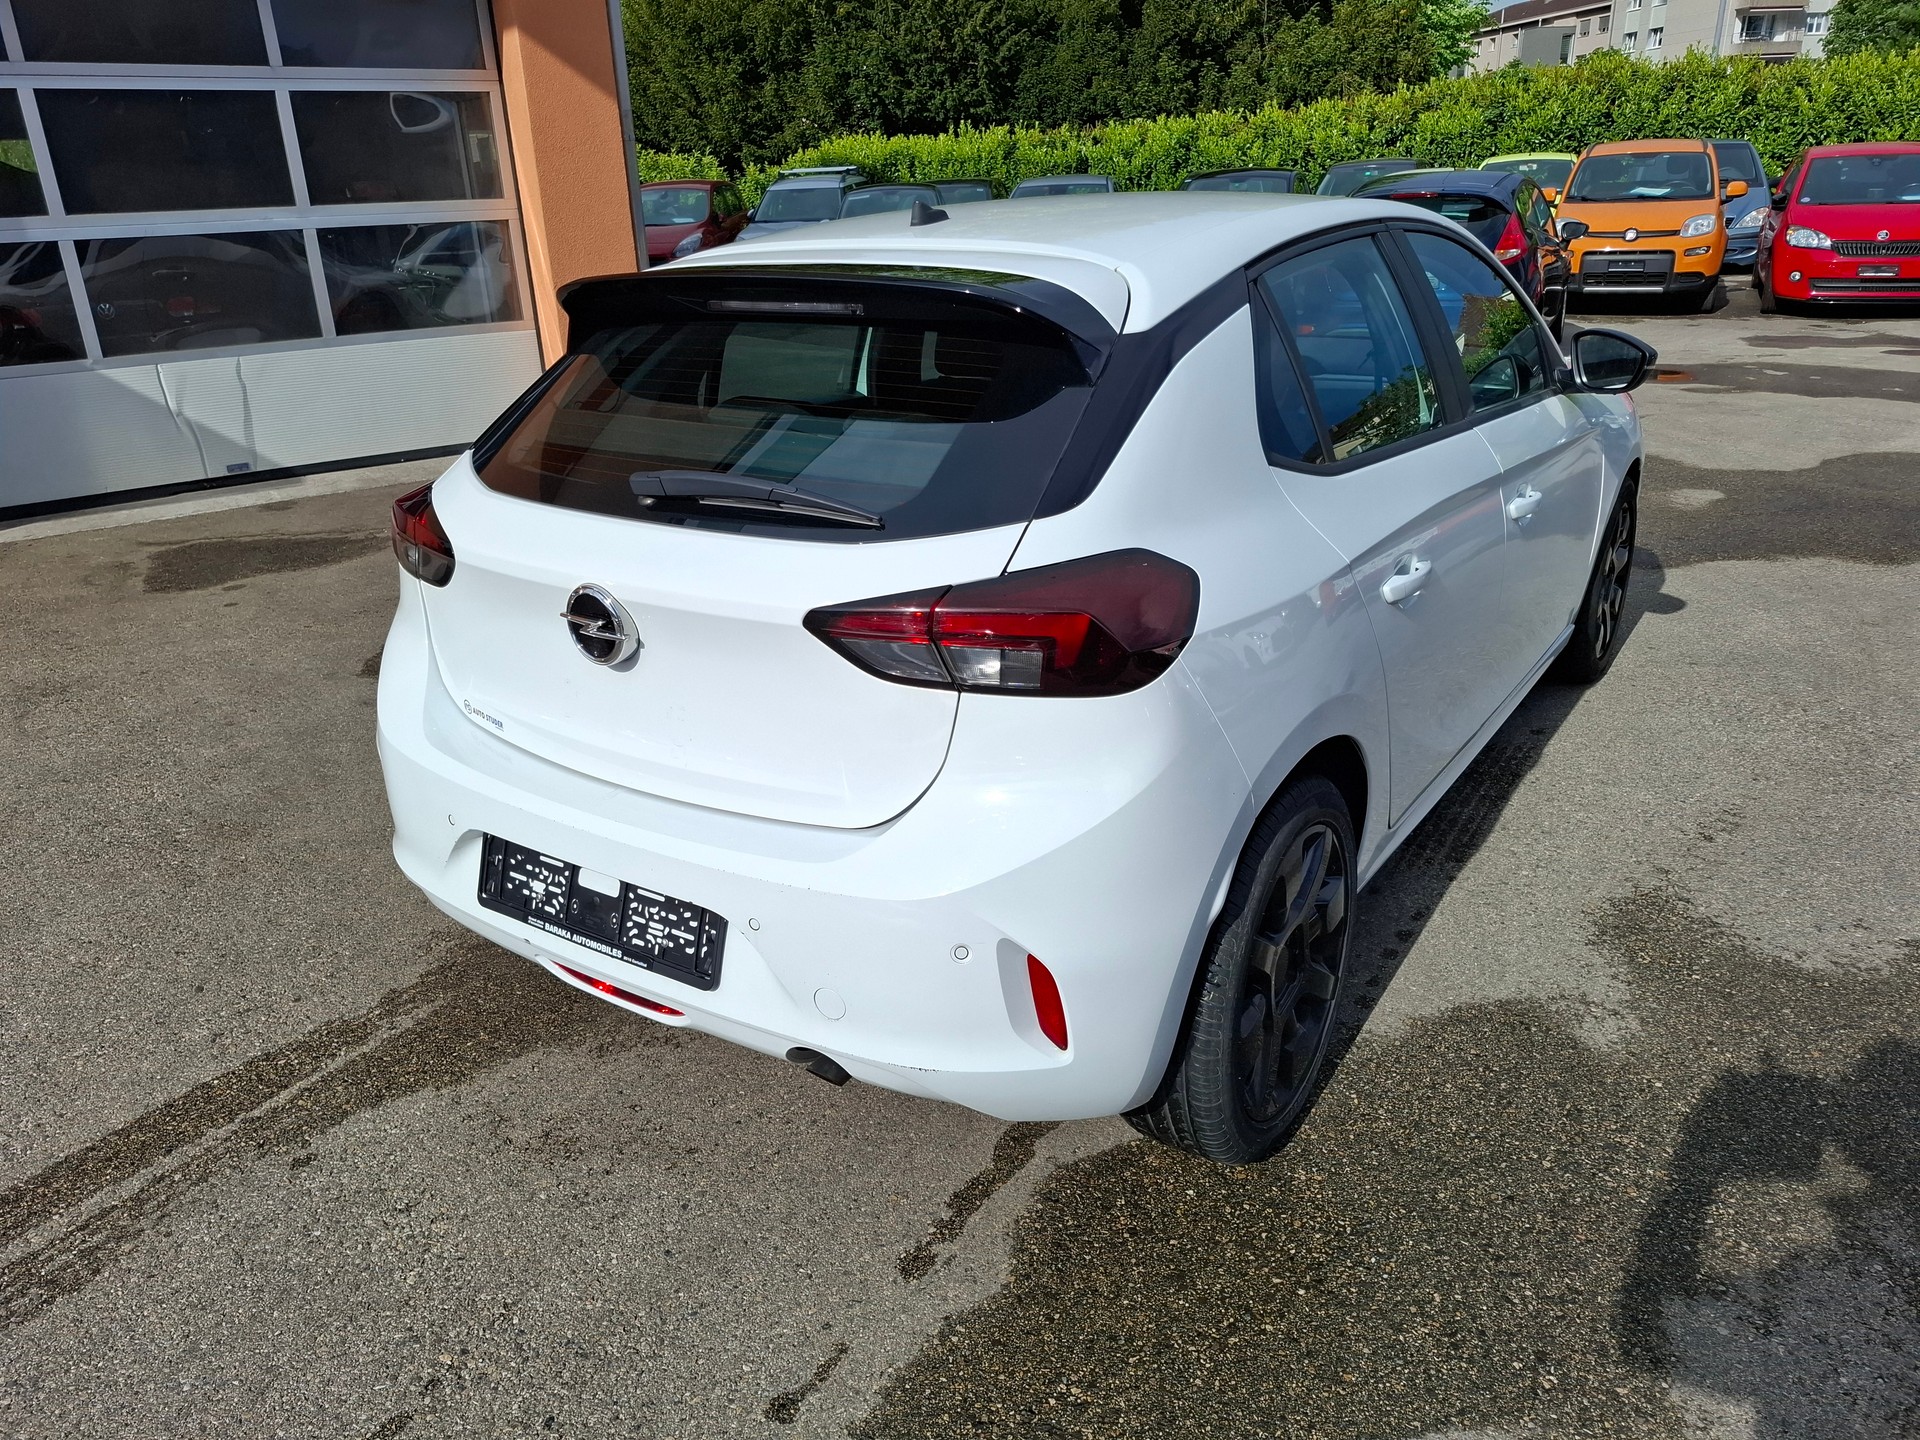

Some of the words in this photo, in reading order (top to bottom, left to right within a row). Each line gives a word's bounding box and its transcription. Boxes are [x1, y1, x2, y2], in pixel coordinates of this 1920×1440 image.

[473, 707, 485, 719] AUTO
[486, 714, 504, 729] STUDER
[544, 922, 571, 940] BARAKA
[572, 934, 622, 958] AUTOMOBILES
